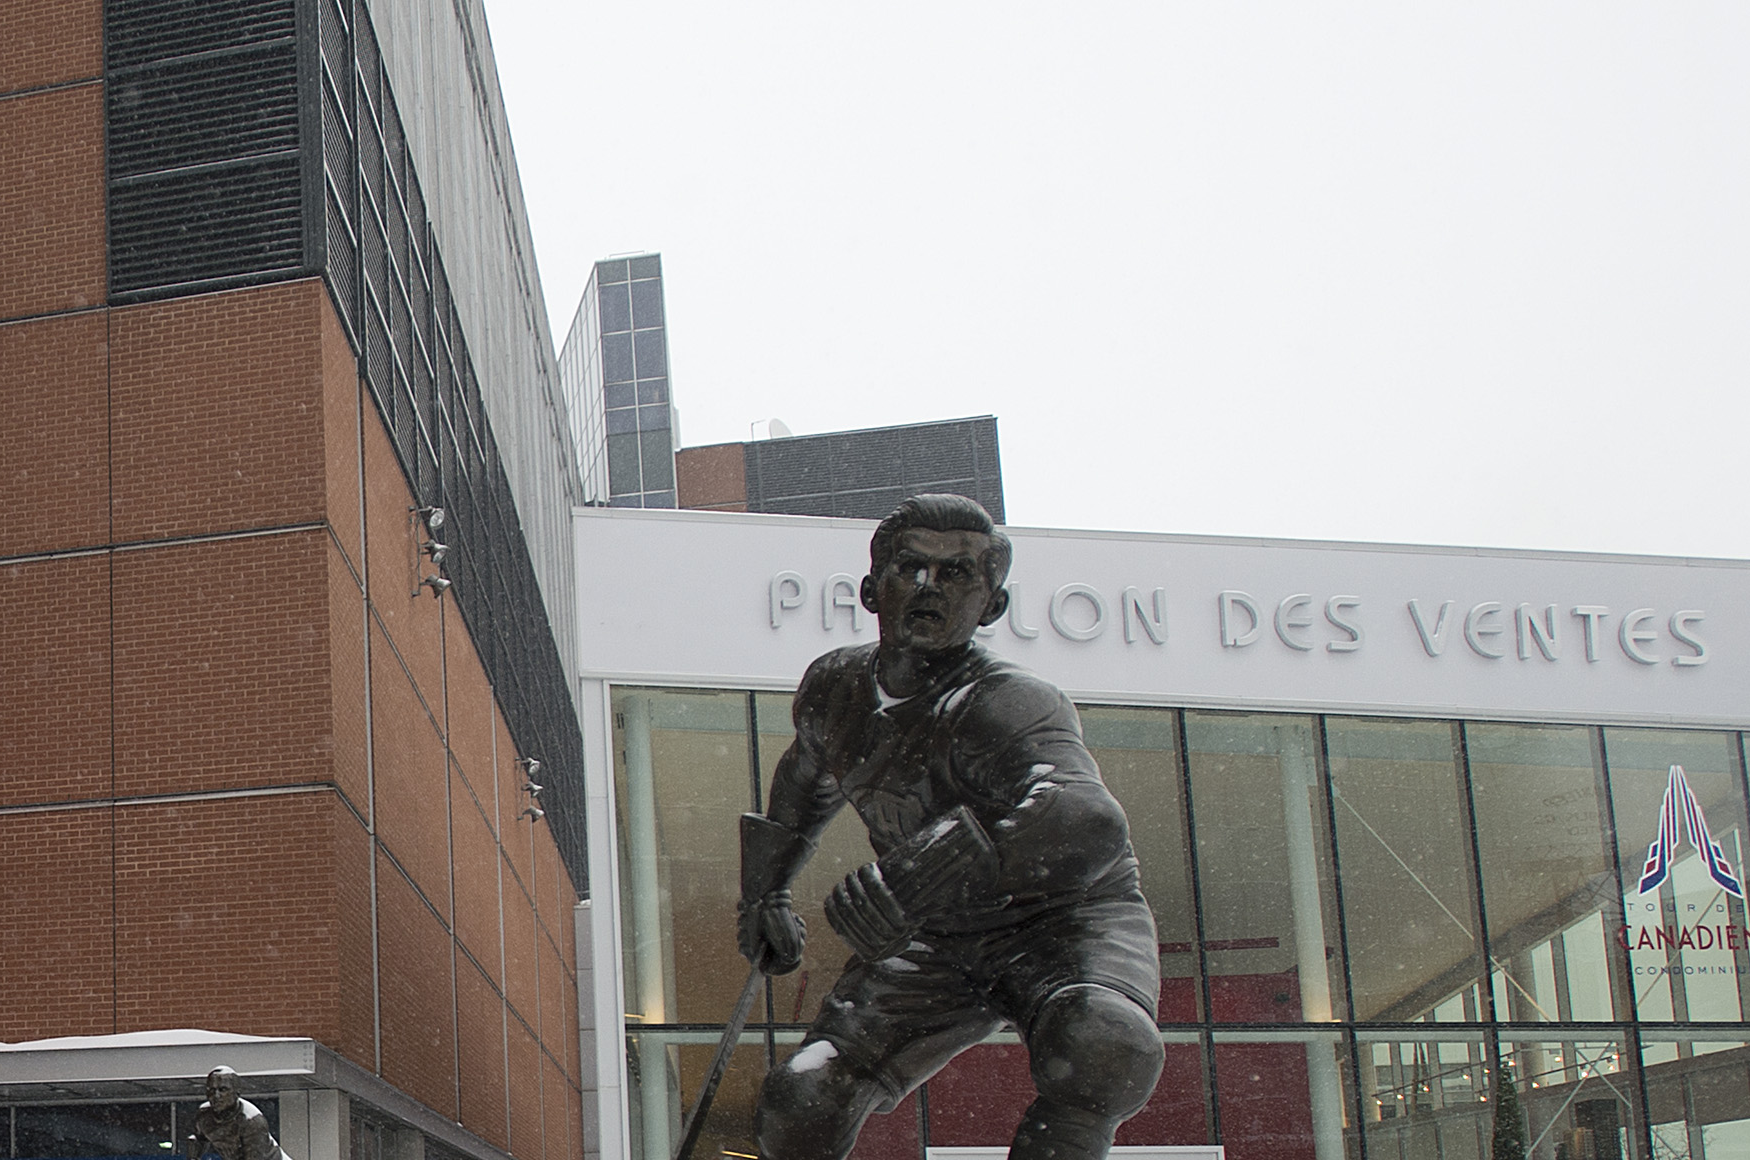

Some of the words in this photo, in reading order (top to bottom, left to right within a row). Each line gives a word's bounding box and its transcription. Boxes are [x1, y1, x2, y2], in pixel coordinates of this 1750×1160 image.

[769, 570, 1169, 646] PALON
[1220, 588, 1366, 653] DES
[1408, 599, 1709, 668] VENTES
[1626, 903, 1696, 912] TOUR
